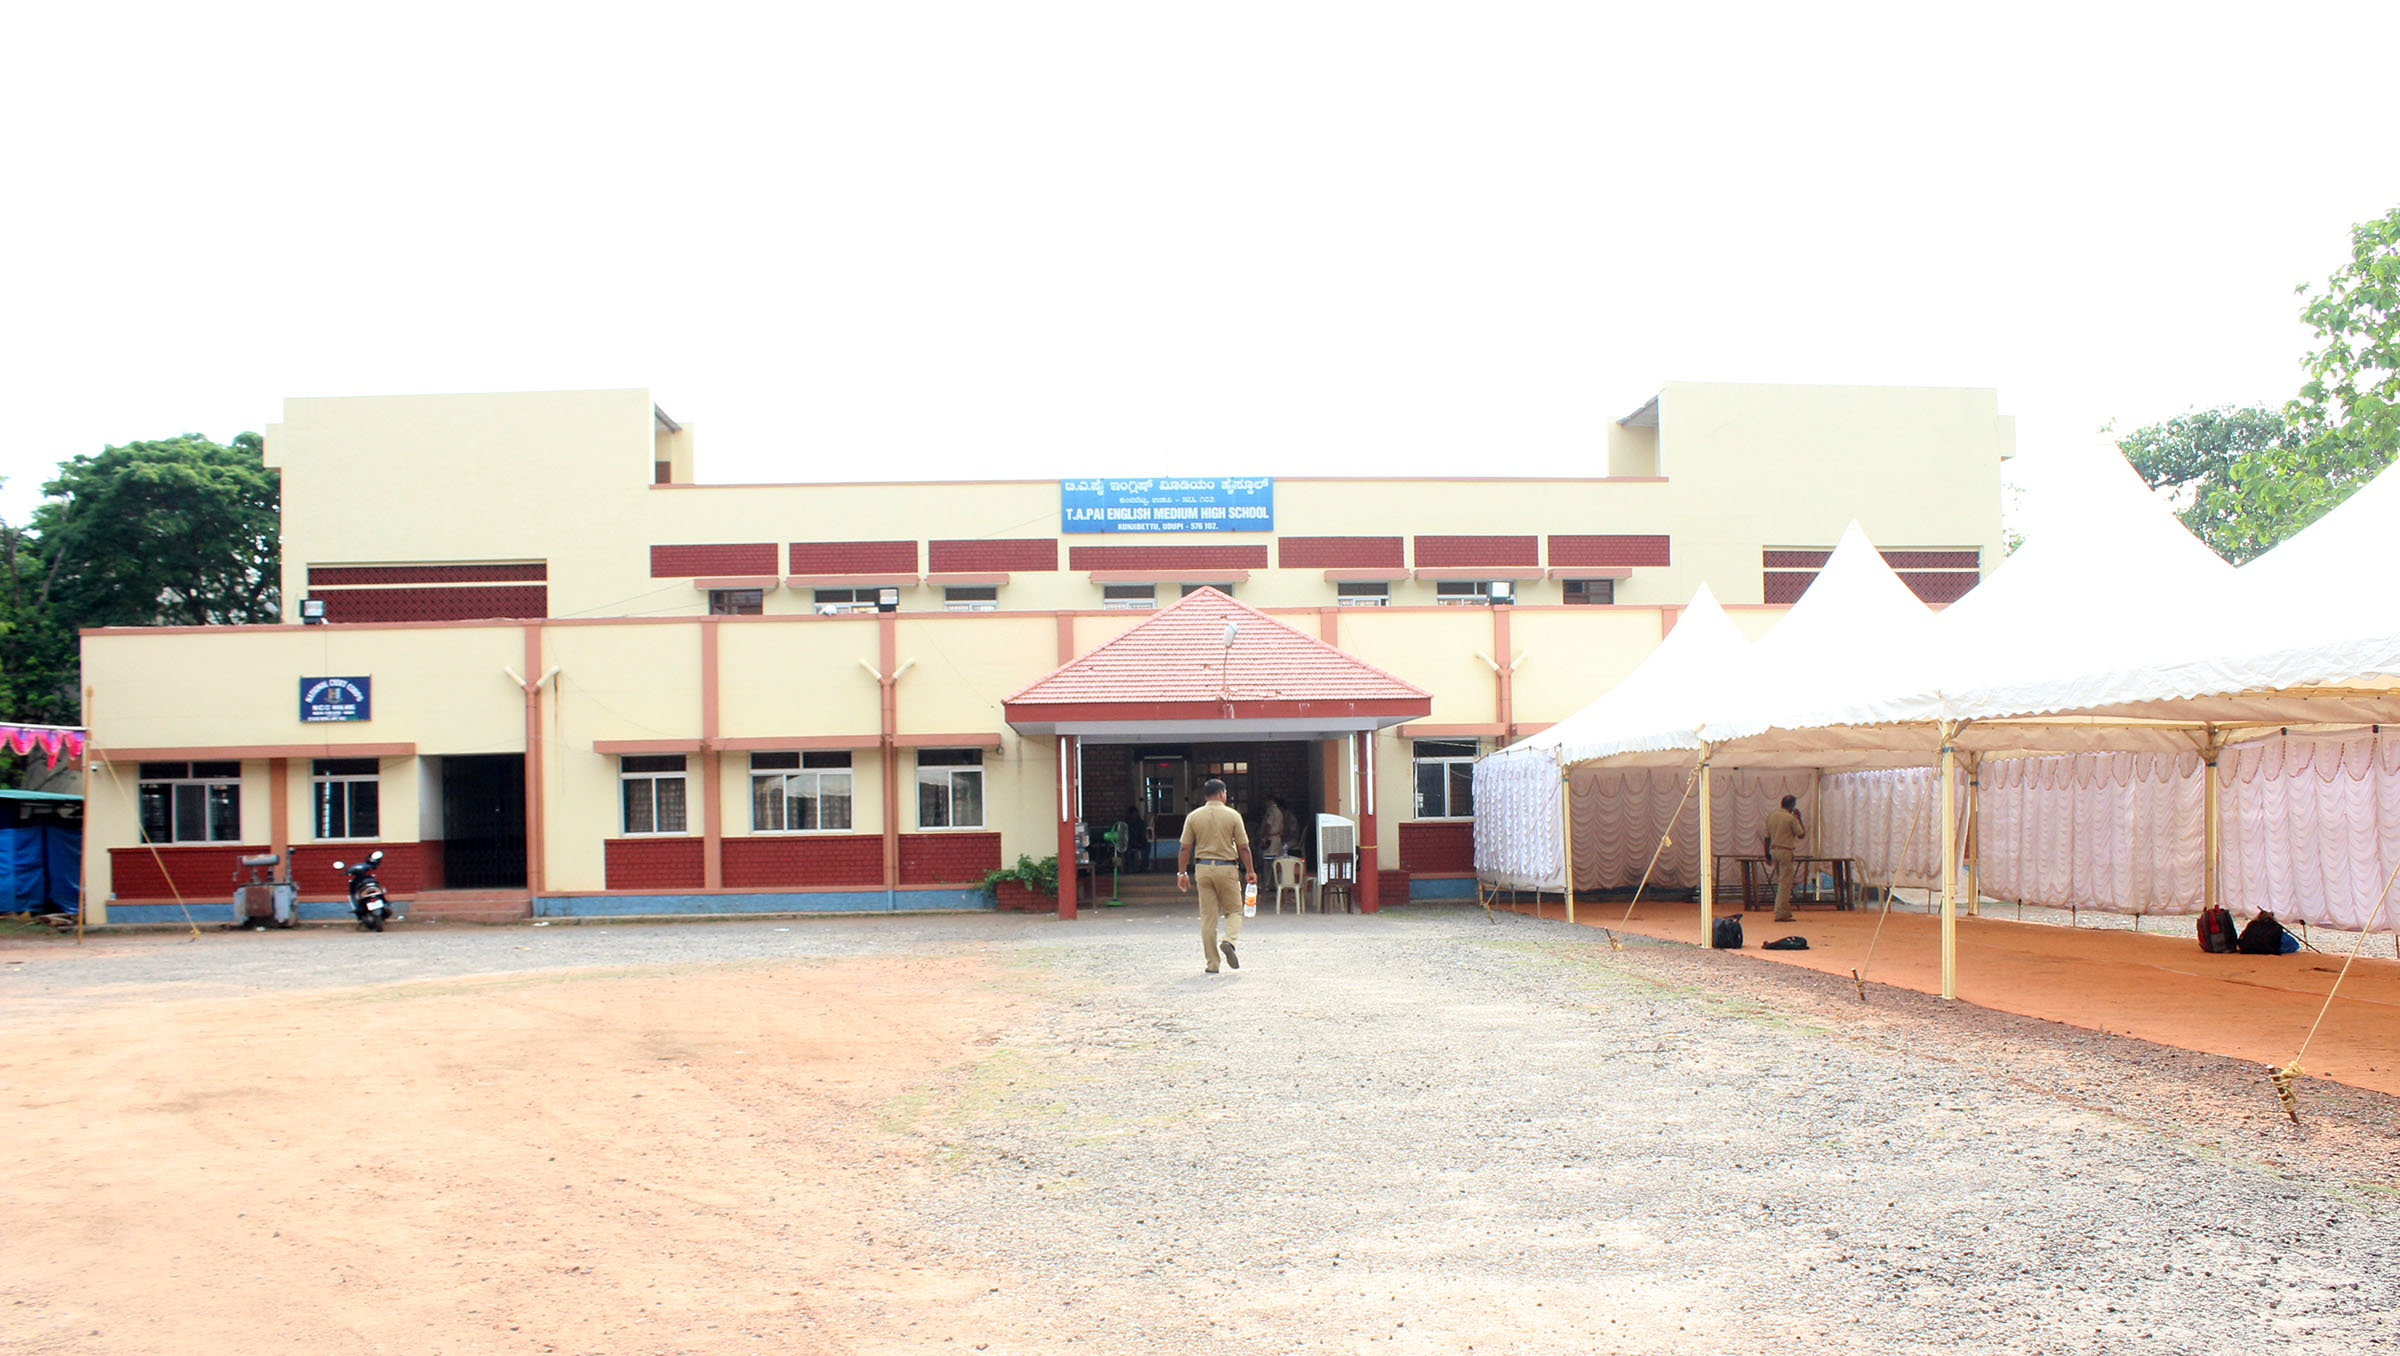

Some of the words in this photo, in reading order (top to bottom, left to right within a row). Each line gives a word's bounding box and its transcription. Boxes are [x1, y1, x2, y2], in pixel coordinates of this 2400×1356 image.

[1065, 508, 1105, 520] T.A.PAI
[1107, 507, 1151, 520] ENGLISH
[1153, 507, 1199, 520] MEDIUM
[1201, 507, 1226, 519] HIGH
[1228, 506, 1269, 519] SCHOOL
[1162, 522, 1184, 530] UDUPI
[1190, 522, 1203, 530] 576
